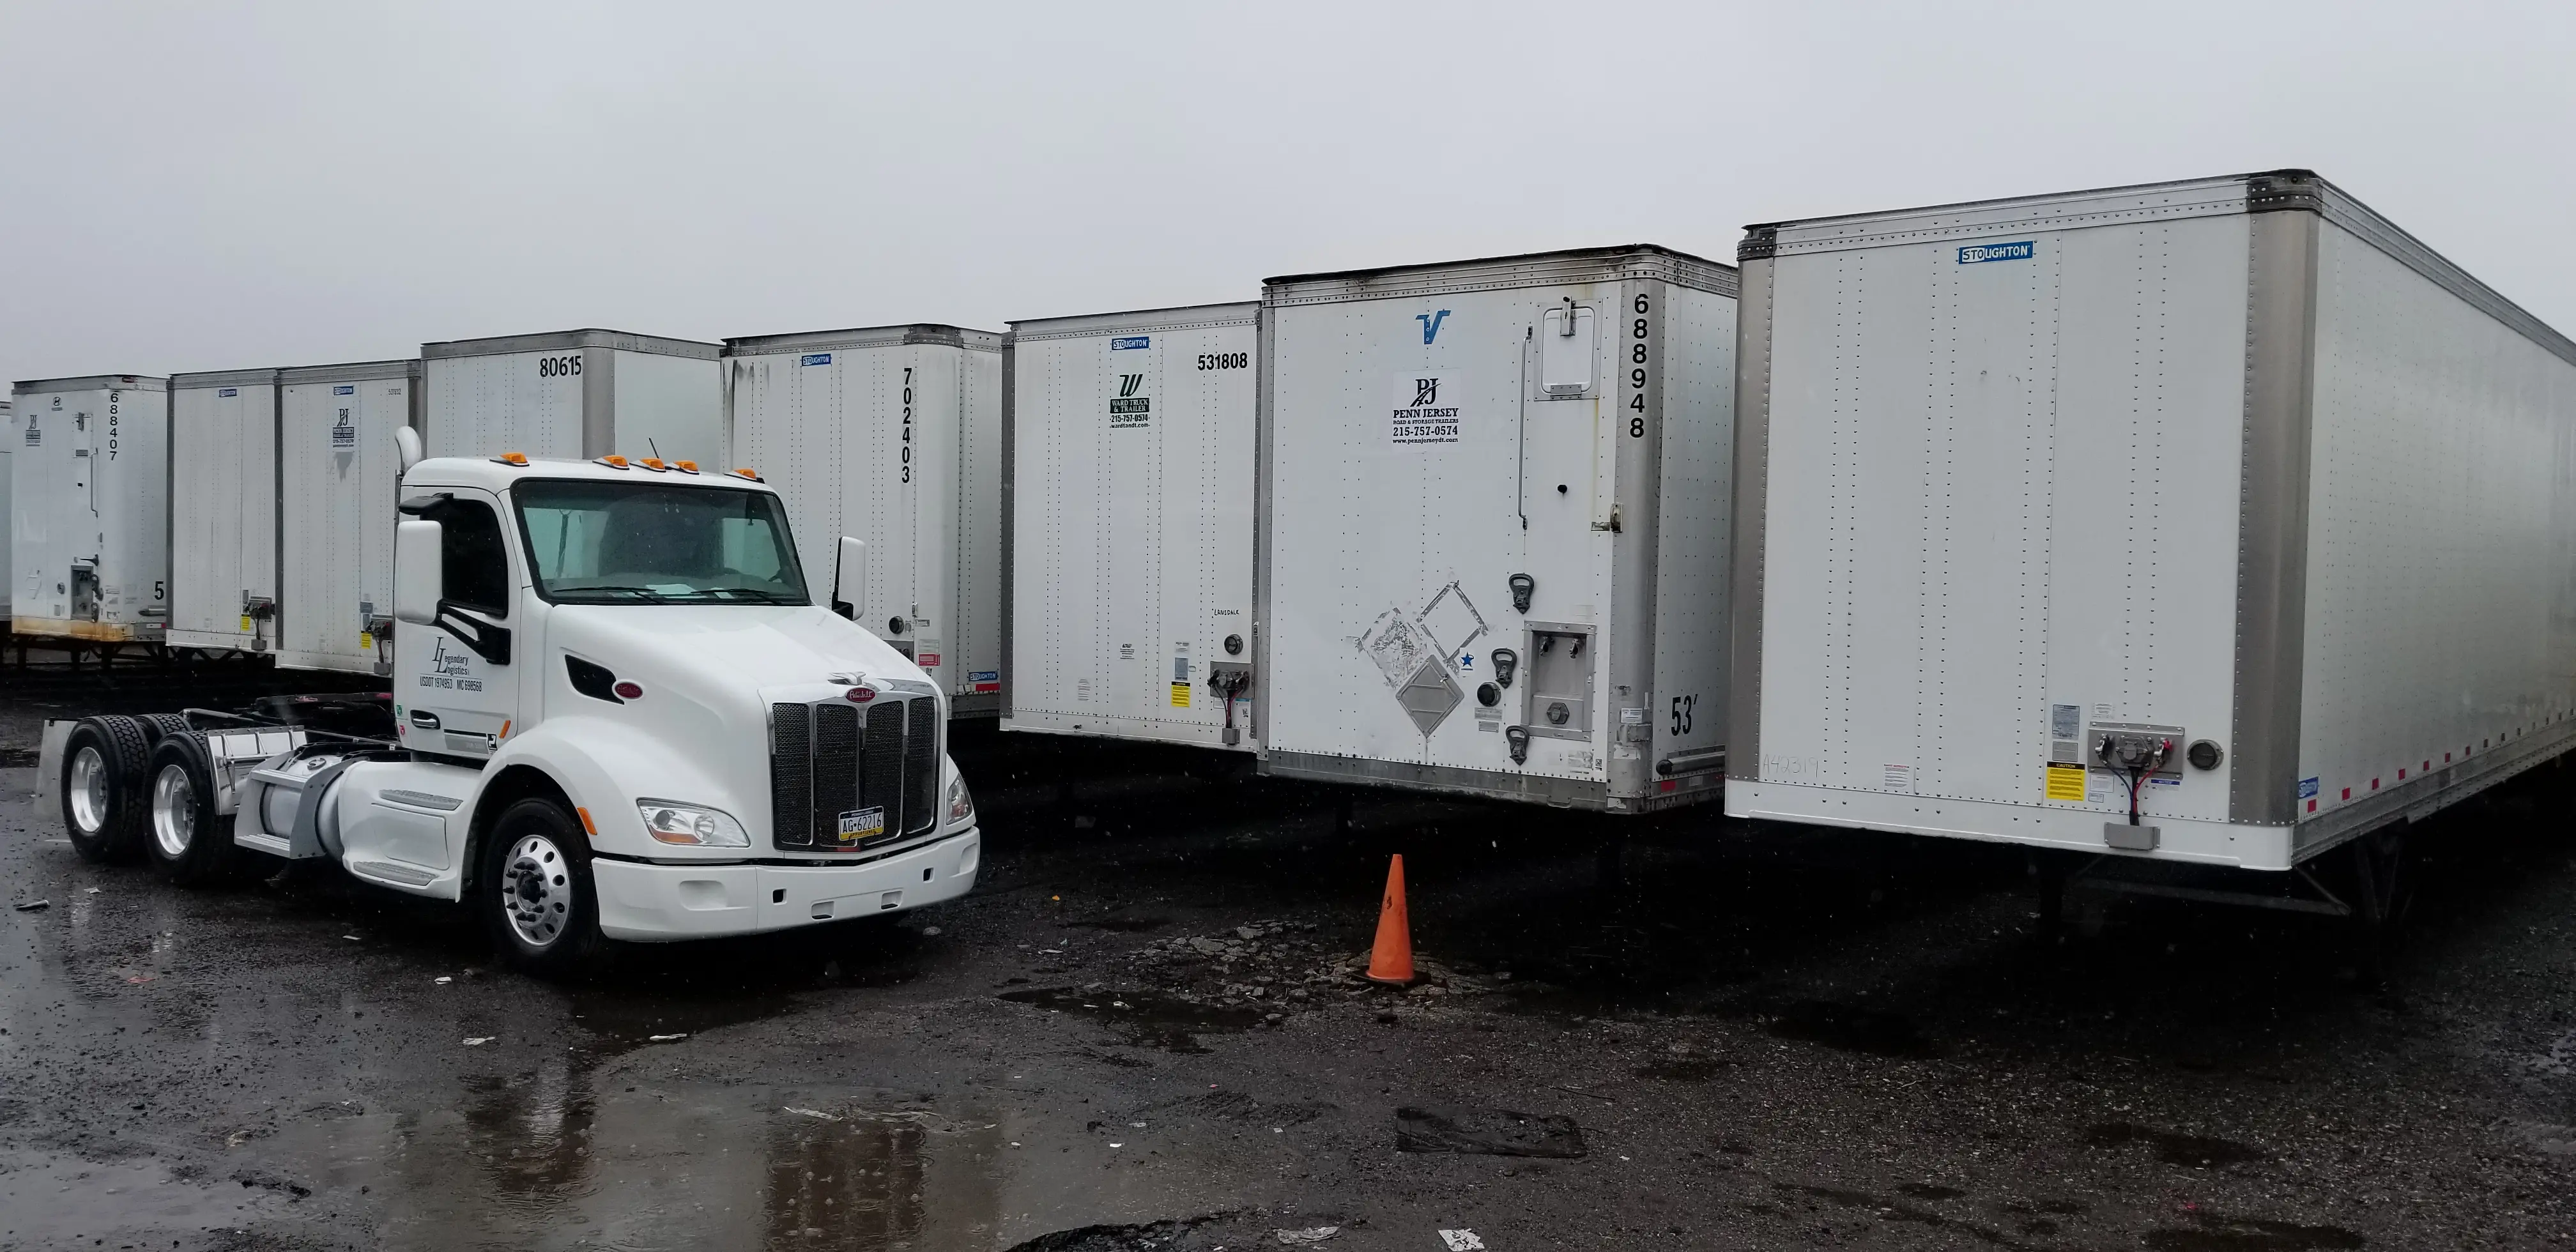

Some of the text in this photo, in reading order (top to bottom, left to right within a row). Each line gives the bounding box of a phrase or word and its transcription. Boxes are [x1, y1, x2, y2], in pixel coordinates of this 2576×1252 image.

[1963, 245, 2028, 261] STOUGHTON
[1114, 339, 1147, 348] STOUGHTON
[540, 355, 581, 378] 80615
[803, 356, 829, 364] STOUGHTON
[1197, 352, 1248, 370] 531808
[1629, 293, 1649, 438] 688948
[1111, 414, 1148, 422] 215-757-0574
[1393, 408, 1459, 418] PENN JERSEY
[109, 393, 118, 461] 688407
[901, 367, 912, 484] 702403
[1393, 425, 1459, 436] 215-757-0574
[420, 676, 434, 688] USDOT
[456, 679, 464, 691] MC
[970, 673, 996, 681] STOUGHTON
